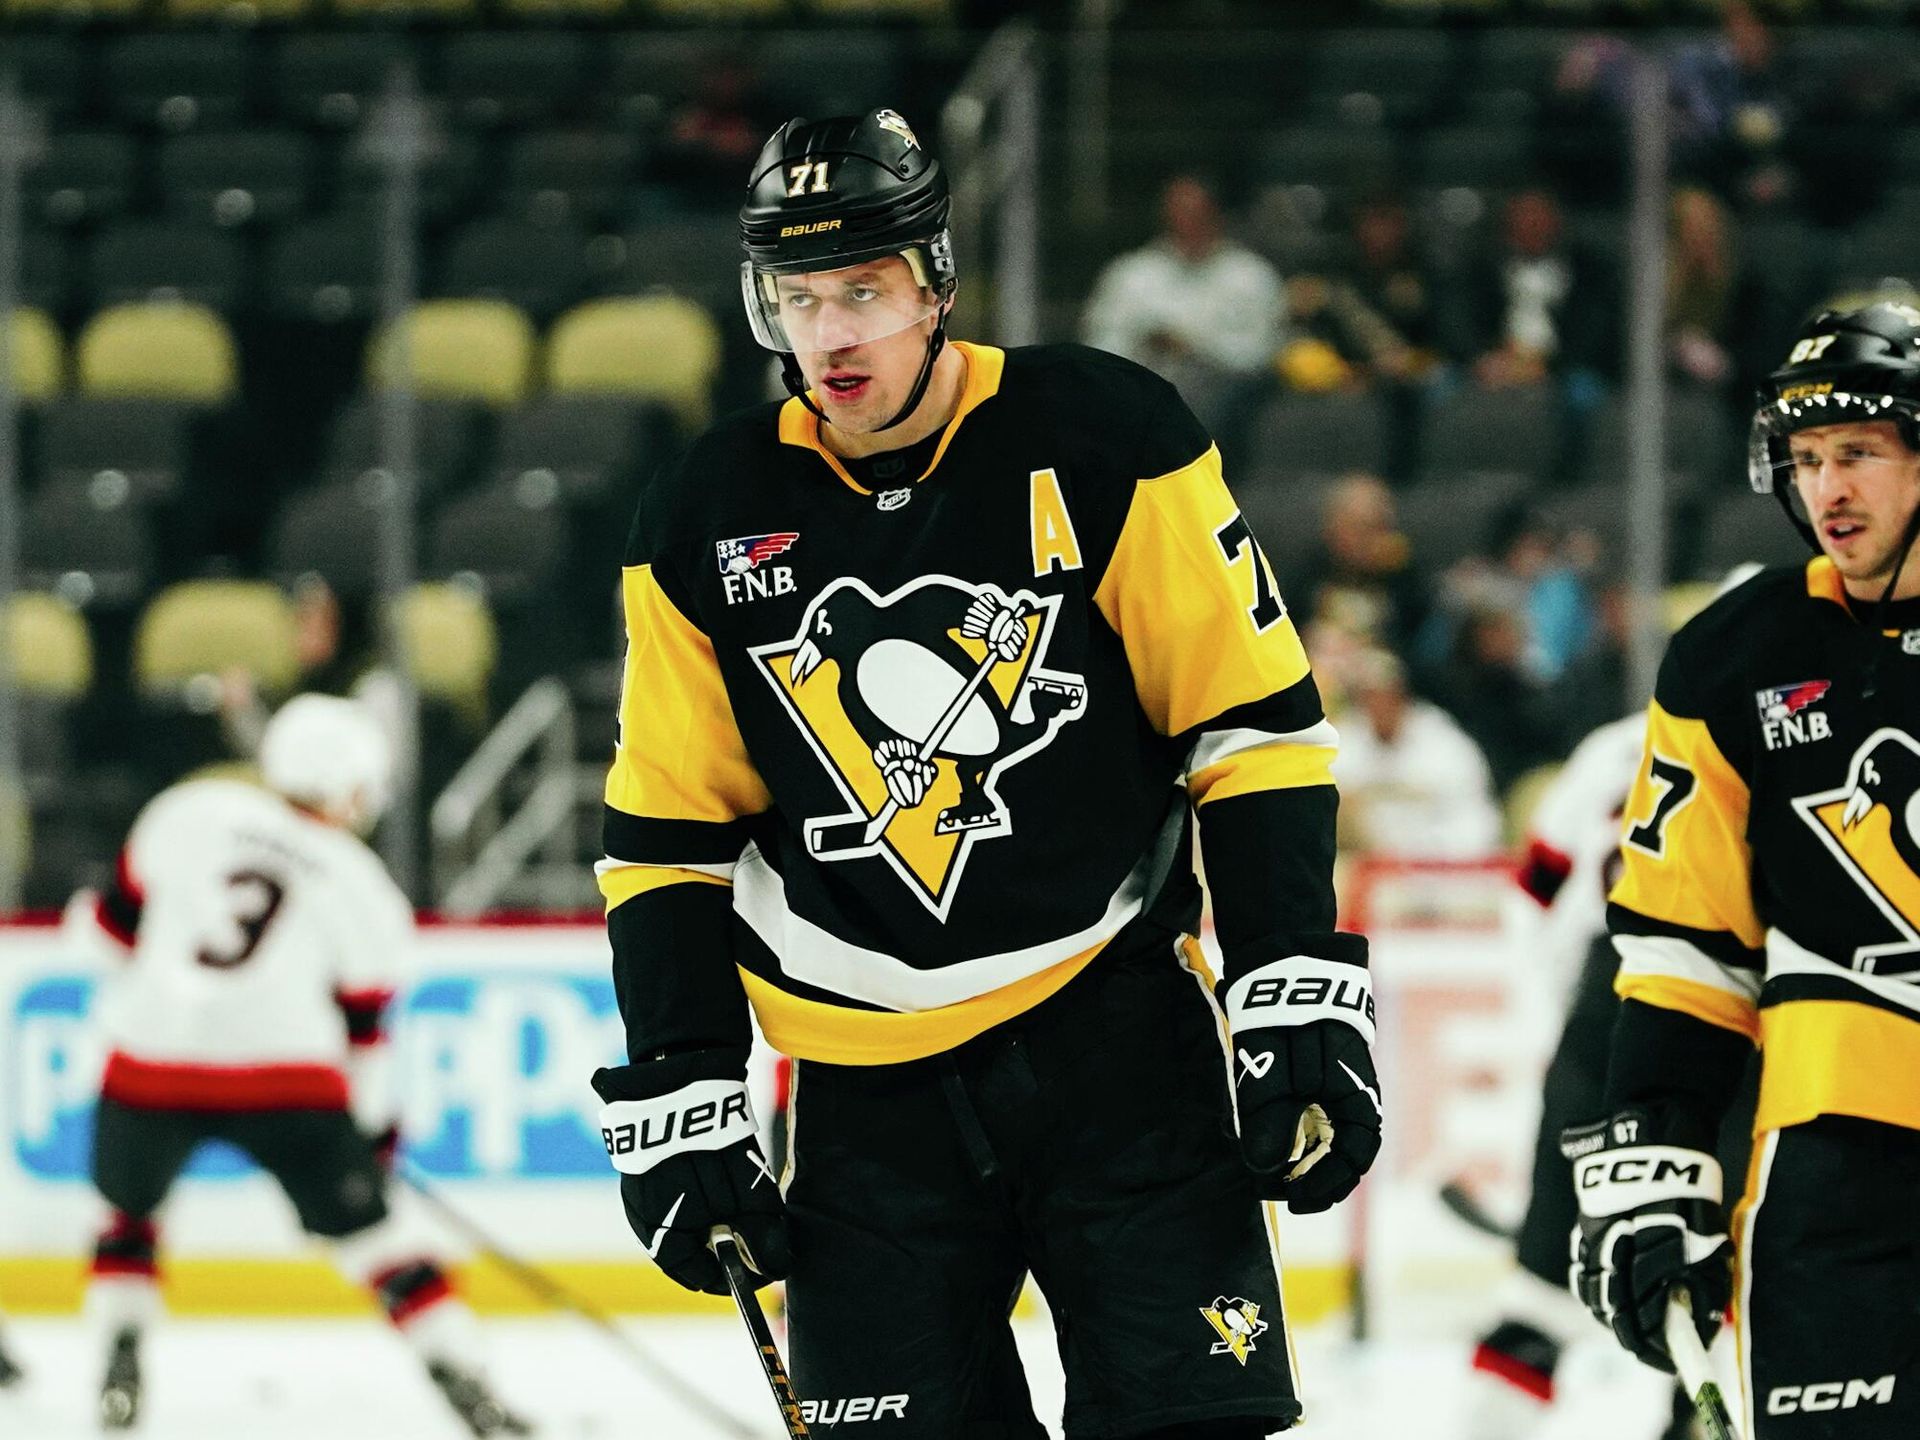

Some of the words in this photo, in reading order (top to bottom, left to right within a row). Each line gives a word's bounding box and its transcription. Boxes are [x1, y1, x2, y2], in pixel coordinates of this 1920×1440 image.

[787, 161, 830, 198] 71
[780, 219, 842, 238] BAUER
[1029, 467, 1084, 579] A
[722, 566, 797, 606] F.N.B.
[1762, 711, 1833, 752] F.N.B.
[195, 868, 285, 971] 3
[1581, 1159, 1703, 1190] CCM
[799, 1393, 910, 1424] AUER
[1766, 1375, 1897, 1417] CCM
